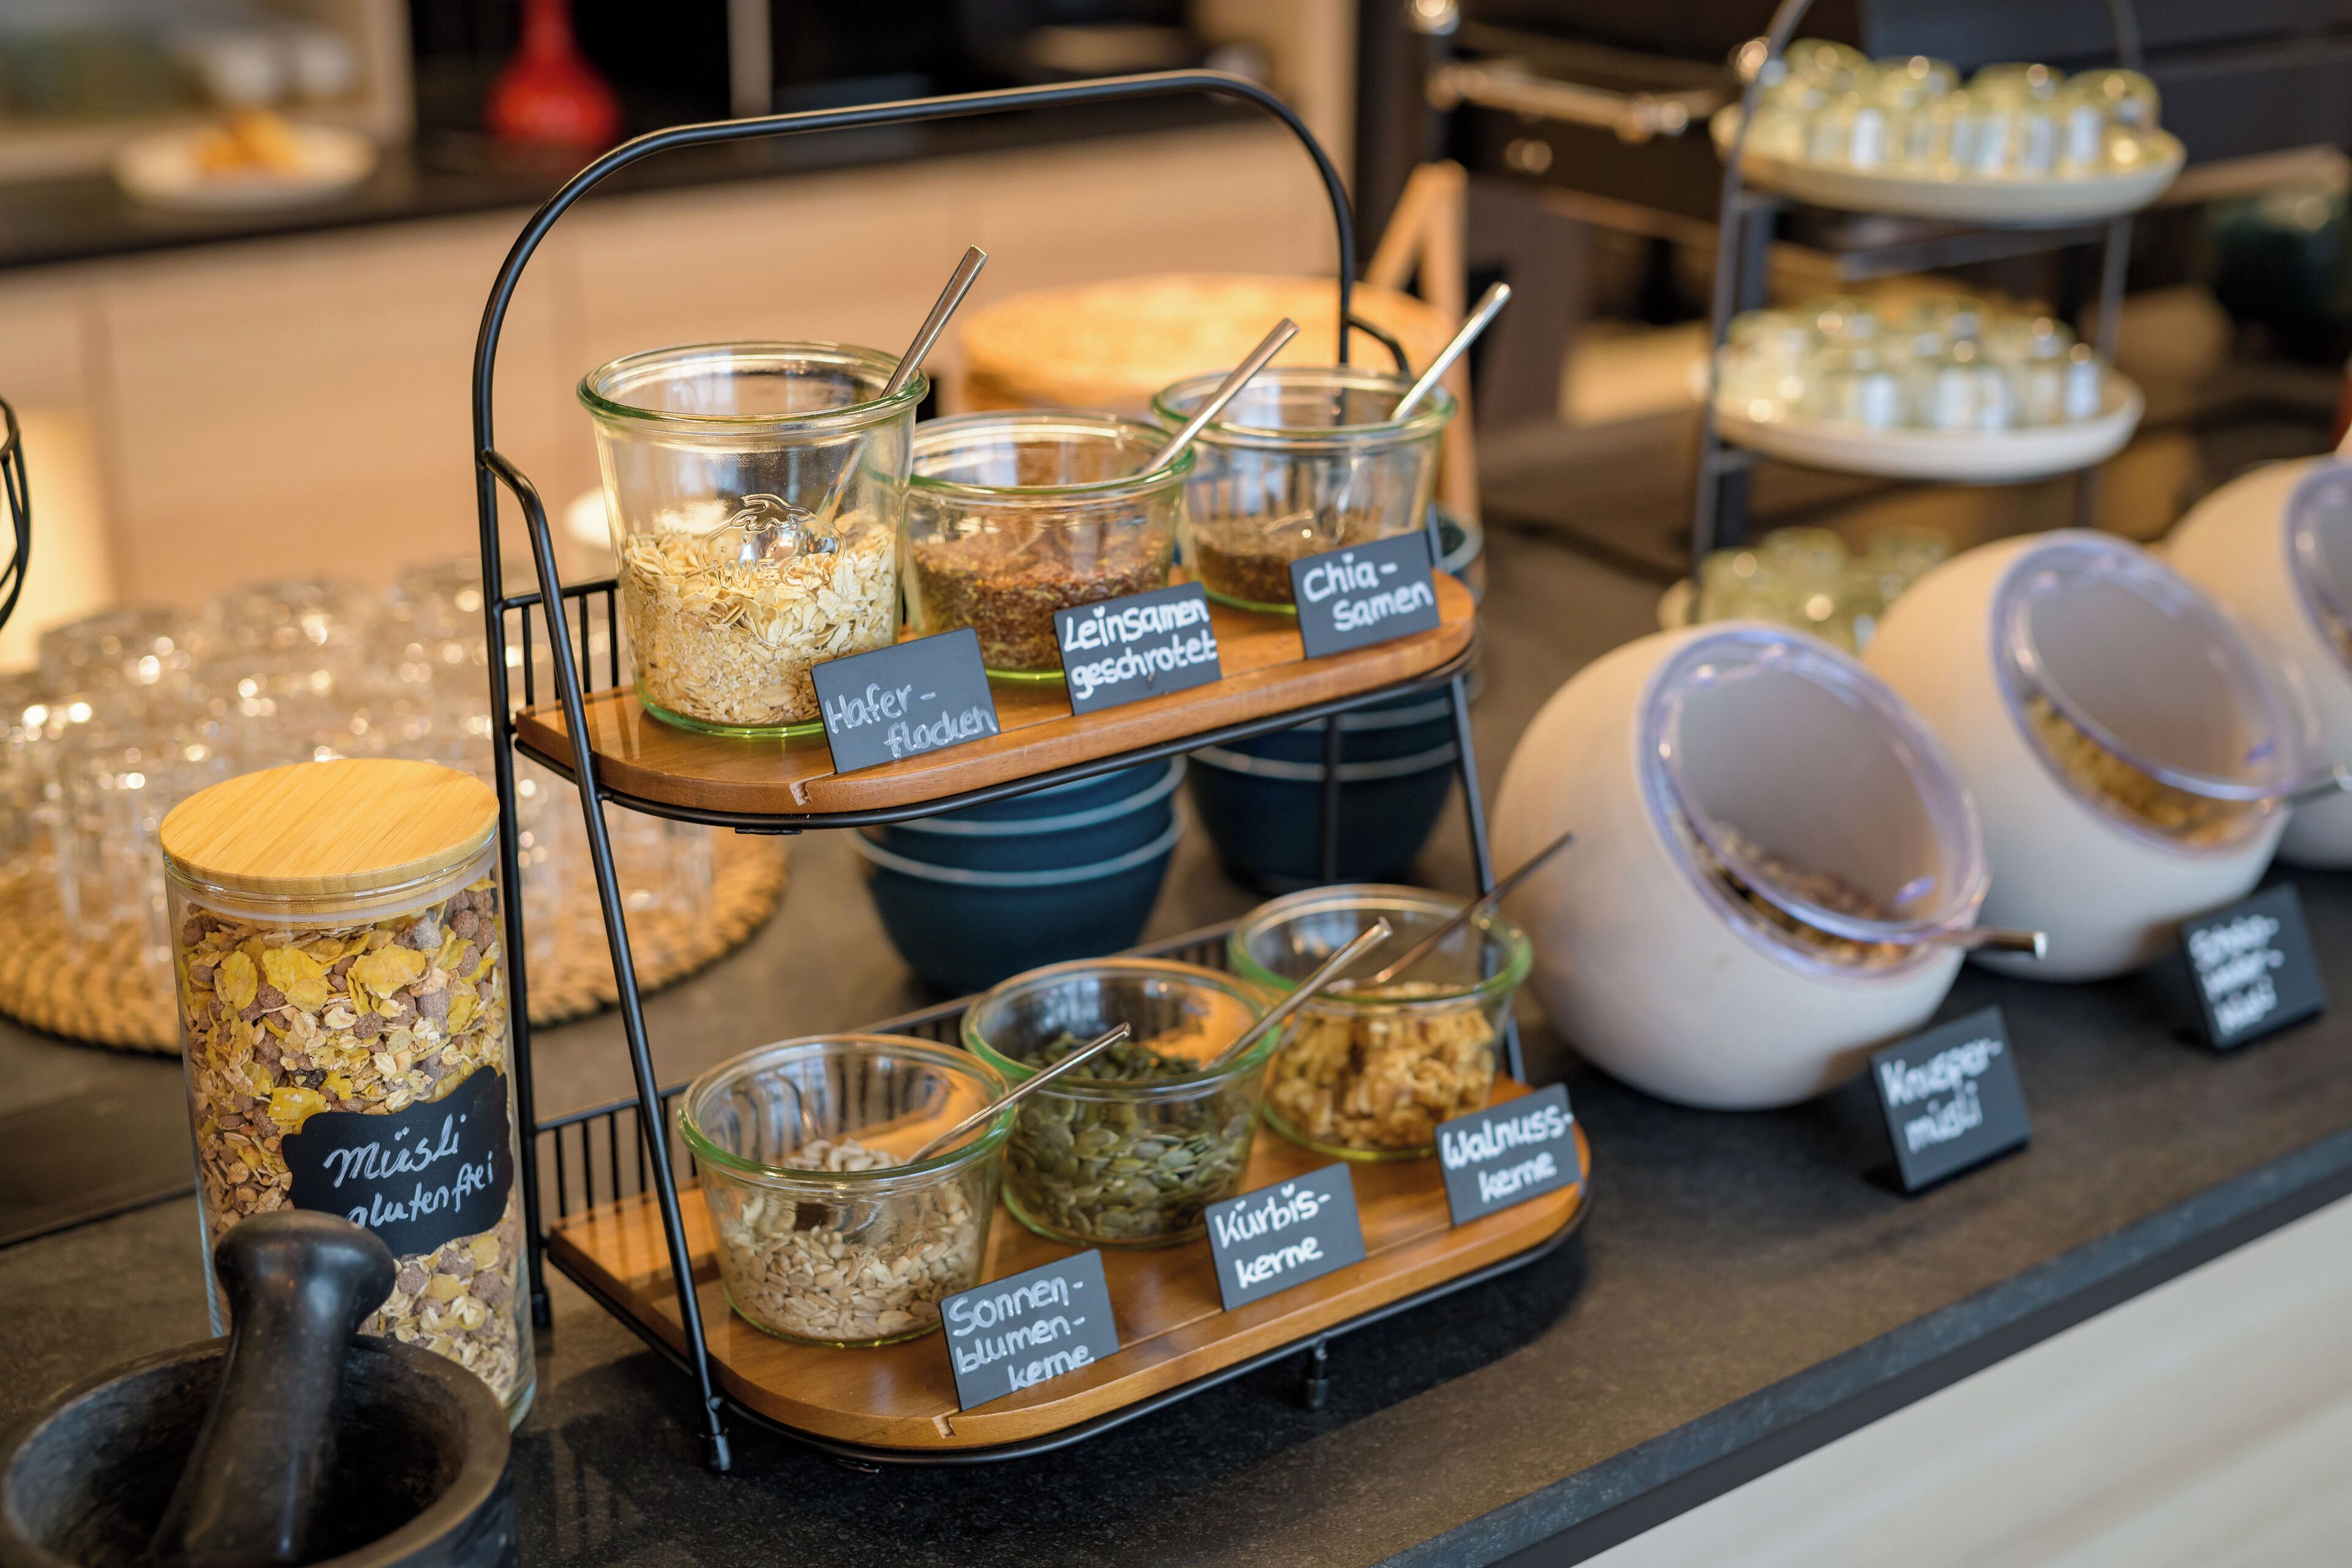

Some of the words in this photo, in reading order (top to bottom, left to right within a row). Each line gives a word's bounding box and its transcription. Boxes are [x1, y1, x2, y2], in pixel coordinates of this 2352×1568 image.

[1303, 552, 1398, 603] Chia-
[1063, 598, 1210, 652] Leinsamen
[1071, 628, 1218, 699] geschrotet
[825, 683, 937, 734] Hafer-
[884, 706, 998, 759] flocken
[1442, 1104, 1574, 1170] Walnuss-
[1478, 1152, 1558, 1204] kerne
[1215, 1183, 1332, 1249] Kürbis-
[1235, 1237, 1324, 1289] kerne
[949, 1276, 1084, 1336] Sonnen-
[956, 1316, 1085, 1375] blumen-
[1007, 1345, 1095, 1392] kerne
